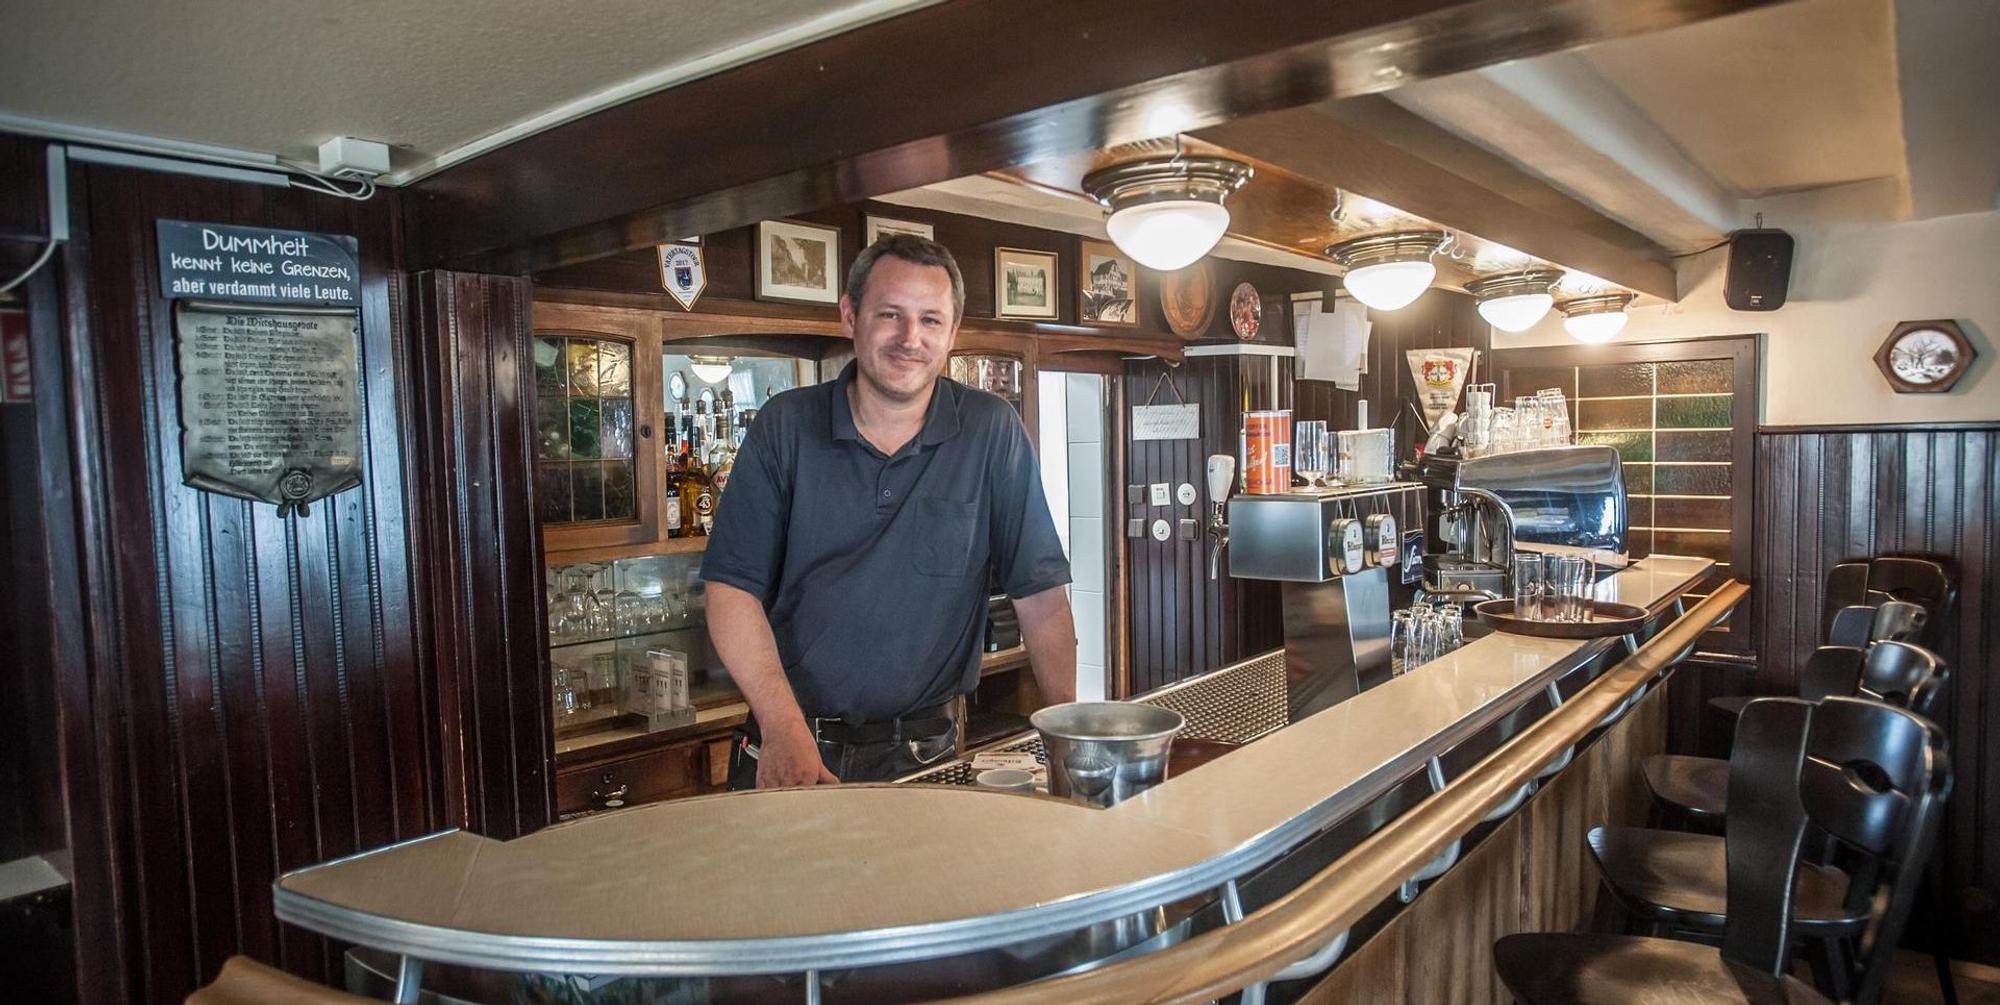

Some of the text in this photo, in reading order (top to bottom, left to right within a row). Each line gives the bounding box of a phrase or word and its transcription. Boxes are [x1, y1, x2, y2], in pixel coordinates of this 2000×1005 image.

[203, 228, 309, 257] Dummheit
[171, 252, 352, 281] kennt keine Grenzen,
[172, 277, 353, 301] aber verdammt viele Leute.
[225, 316, 245, 326] Die
